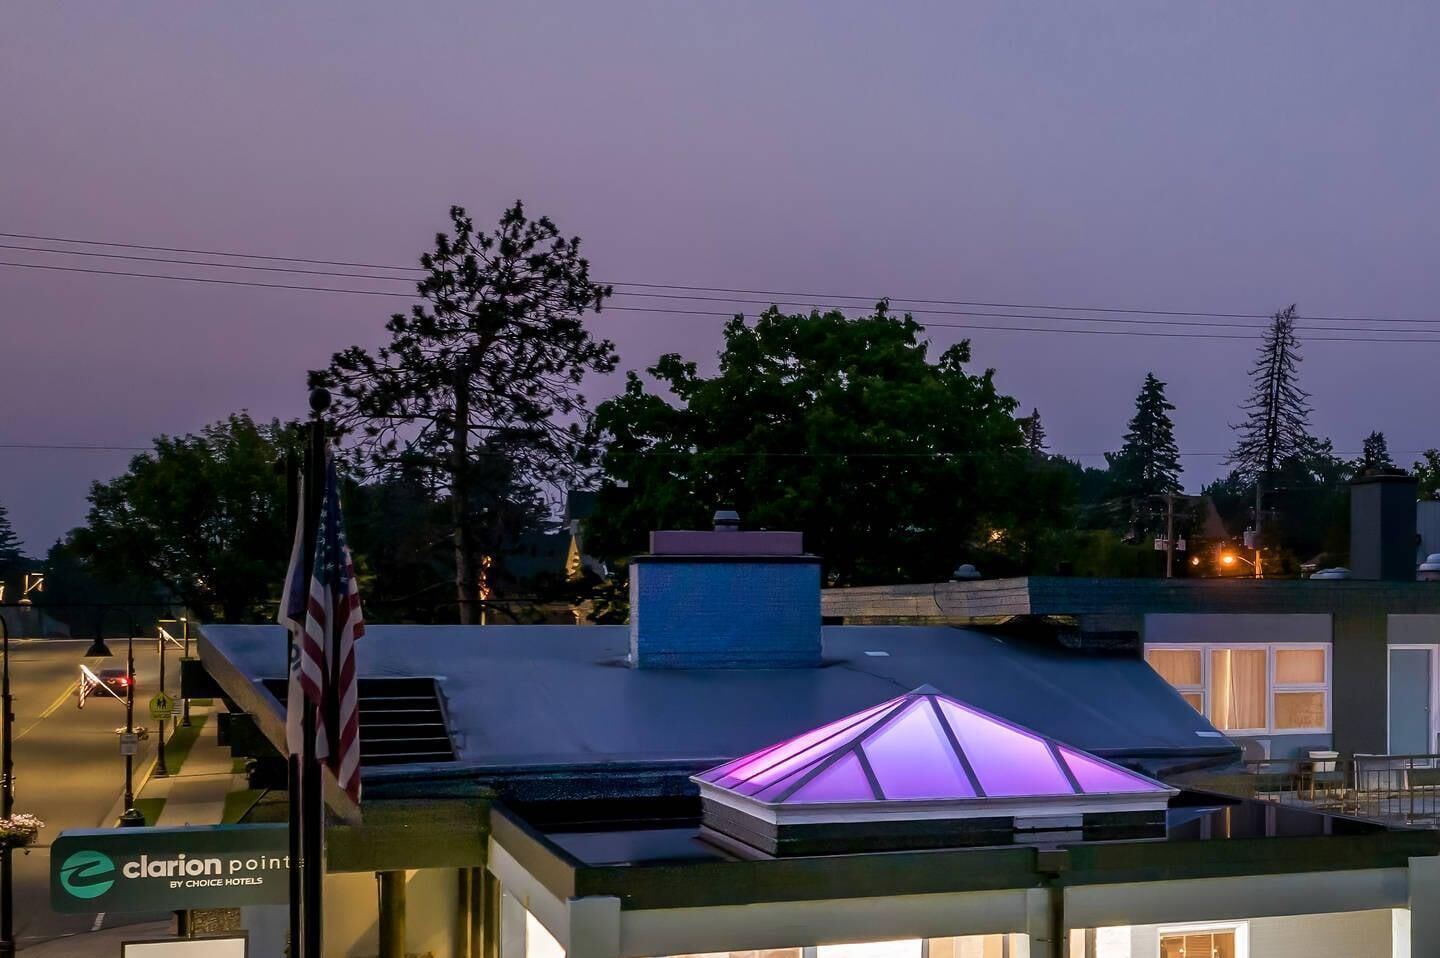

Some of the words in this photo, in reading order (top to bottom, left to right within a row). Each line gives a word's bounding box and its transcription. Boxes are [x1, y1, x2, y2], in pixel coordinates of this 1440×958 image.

[123, 854, 222, 879] clarion
[170, 880, 183, 889] BY
[186, 878, 223, 888] CHOICE
[225, 877, 263, 886] HOTELS
